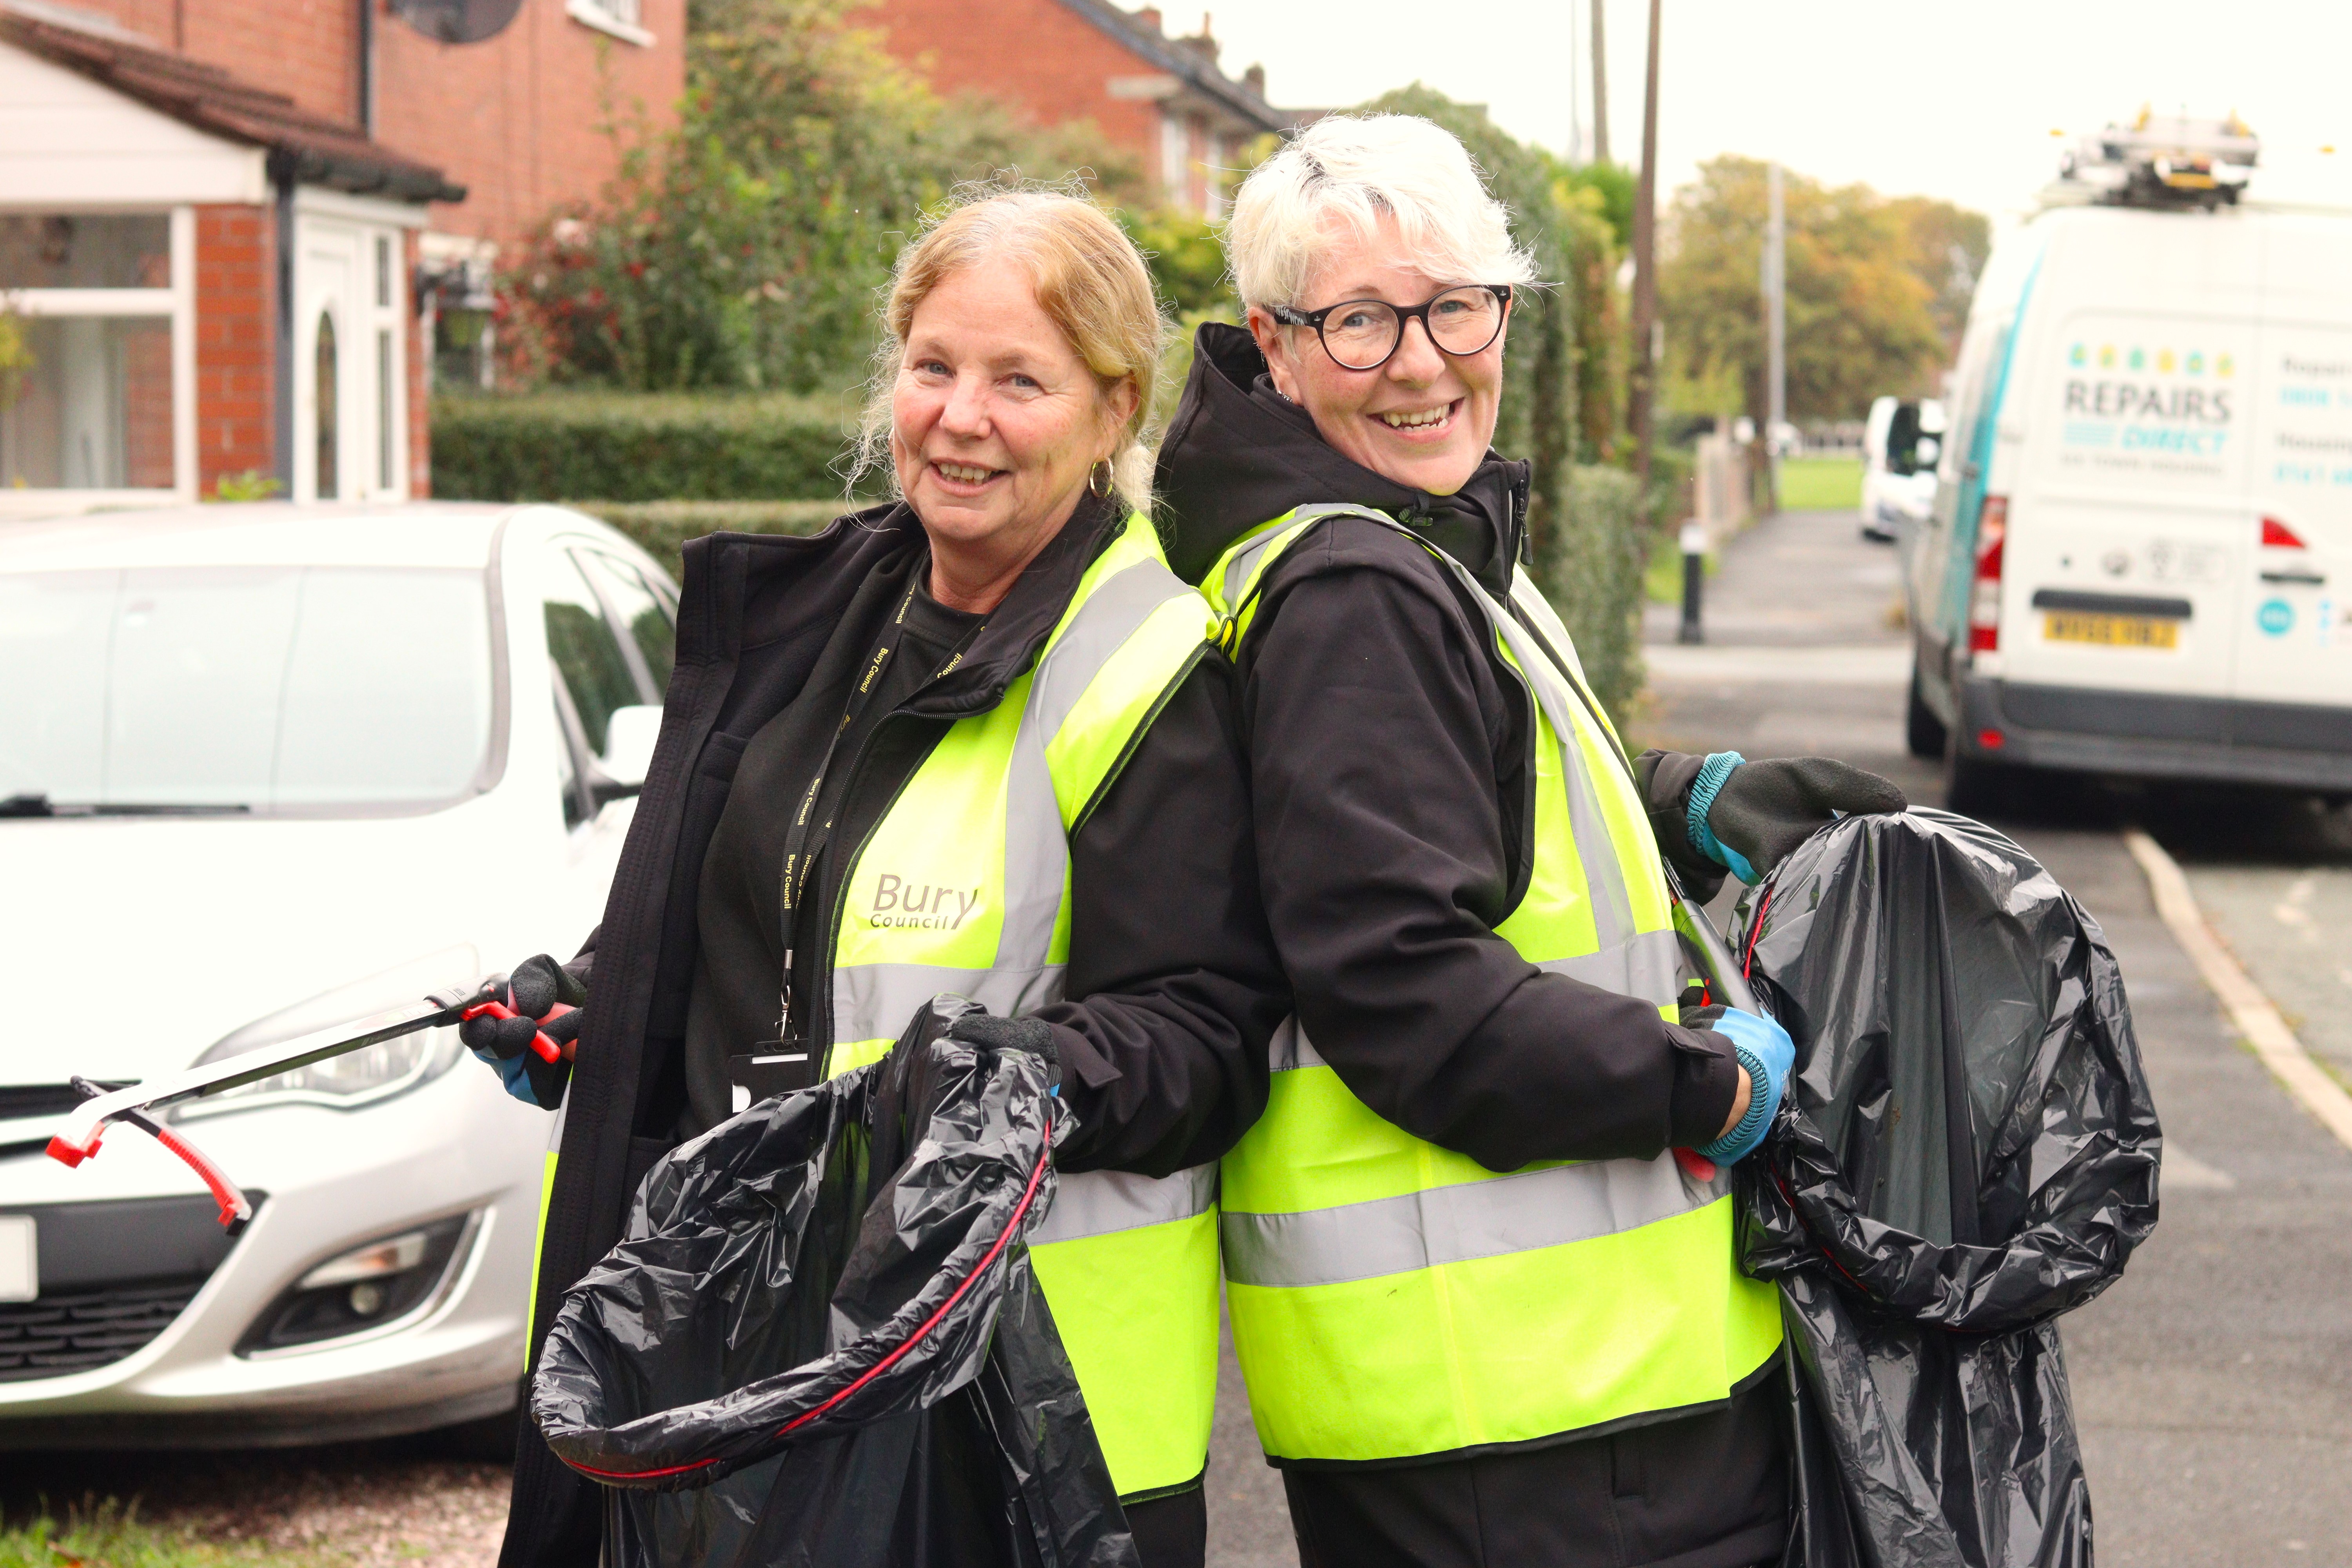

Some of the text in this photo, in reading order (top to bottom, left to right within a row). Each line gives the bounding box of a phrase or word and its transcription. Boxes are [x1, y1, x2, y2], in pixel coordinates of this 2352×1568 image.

[2064, 380, 2232, 424] REPAIRS
[2122, 425, 2227, 456] DIRECT
[895, 596, 911, 624] Council
[860, 648, 889, 693] Bury Council
[797, 778, 820, 825] Bury Council
[784, 854, 795, 909] Bury Council
[799, 855, 812, 887] Council
[870, 913, 948, 929] Council
[873, 874, 978, 930] Bury
